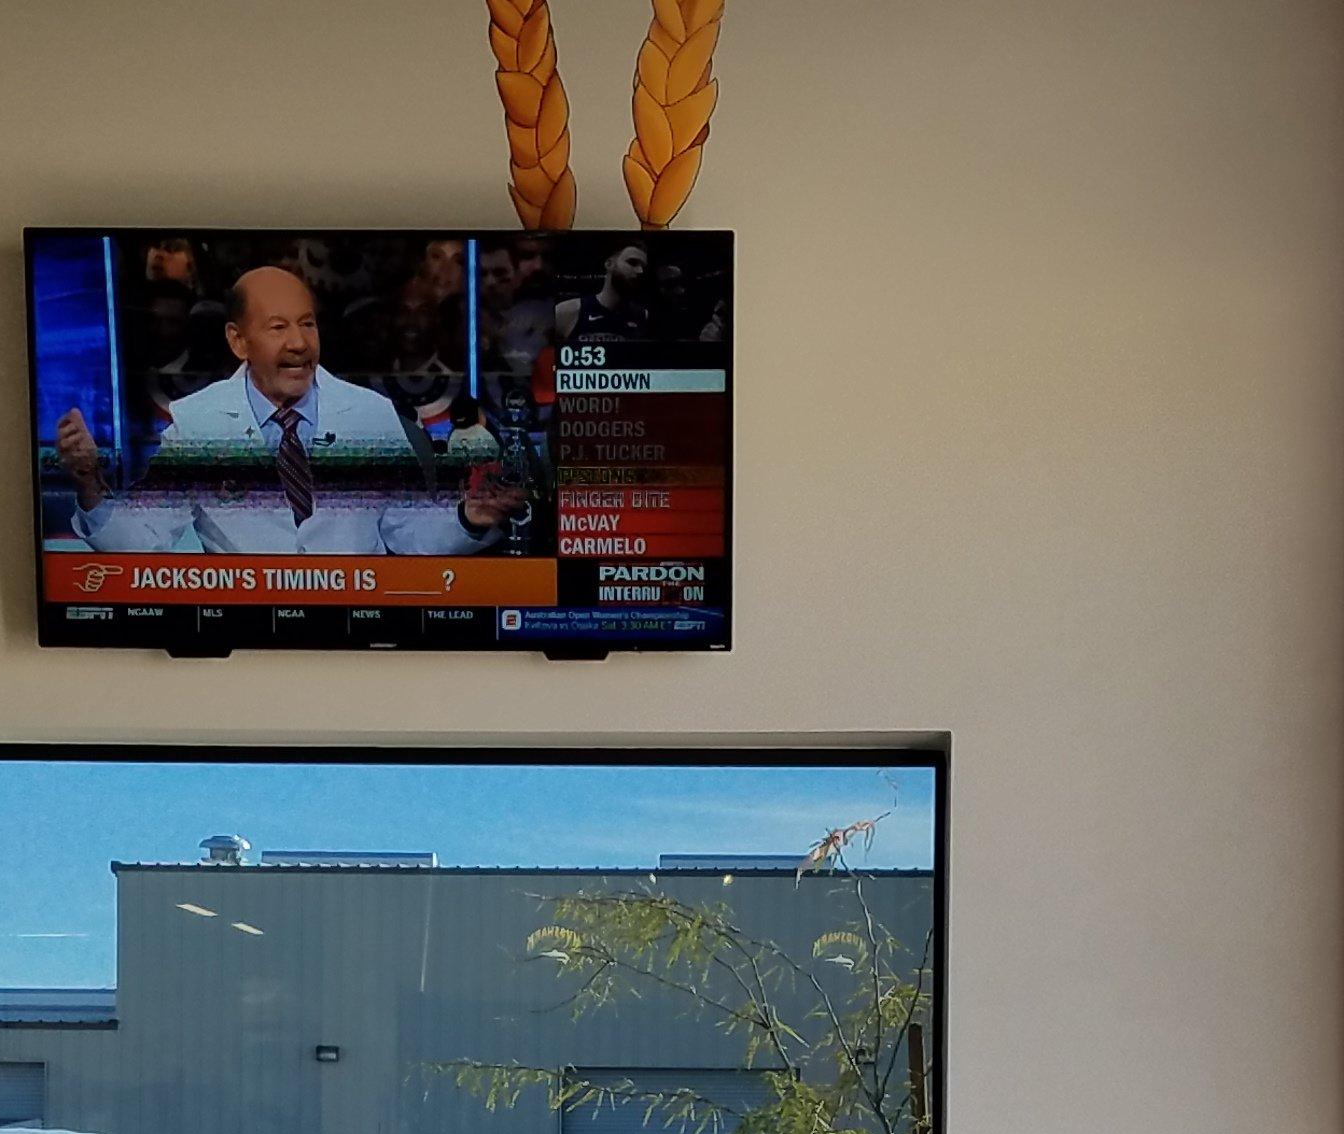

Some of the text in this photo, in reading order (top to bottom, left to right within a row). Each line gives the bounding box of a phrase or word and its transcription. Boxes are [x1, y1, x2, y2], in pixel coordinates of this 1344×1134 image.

[560, 346, 606, 366] 0:53
[560, 373, 651, 390] RUNDOWN
[559, 397, 621, 414] WORD!
[560, 421, 646, 438] DODGERS
[560, 444, 666, 462] P.J. TUCKER
[560, 491, 671, 508] FINGER BITE
[560, 514, 621, 532] McVAY
[560, 538, 647, 555] CARMELO
[130, 568, 257, 591] JACKSON'S
[262, 568, 346, 591] TIMING
[353, 569, 377, 591] IS
[599, 566, 705, 581] PARDON
[599, 586, 705, 602] INTERRUON
[277, 608, 305, 618] NCAA
[352, 609, 382, 619] NEWS
[428, 609, 474, 619] THE LEAD
[568, 611, 590, 621] Open
